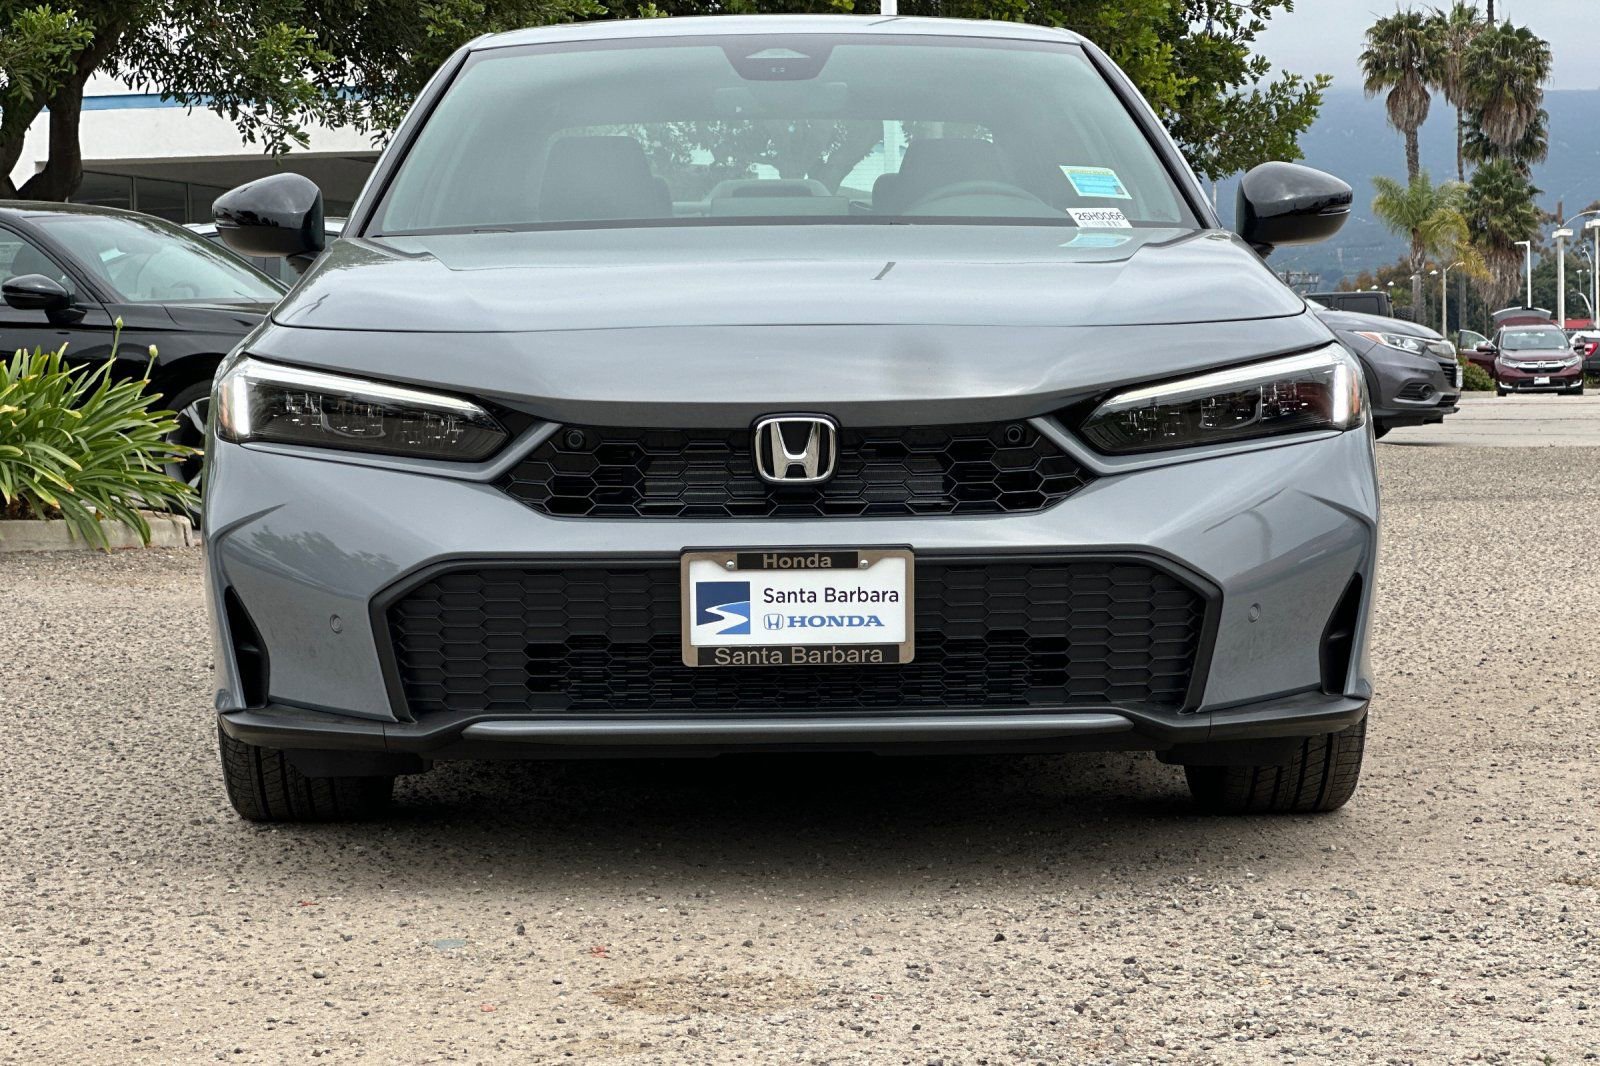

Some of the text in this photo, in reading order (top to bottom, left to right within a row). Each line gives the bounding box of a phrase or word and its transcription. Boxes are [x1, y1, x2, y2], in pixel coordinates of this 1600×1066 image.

[762, 553, 832, 569] Honda
[763, 586, 899, 603] Santa Barbara
[787, 615, 885, 627] HONDA
[714, 646, 883, 665] Santa Barbara
